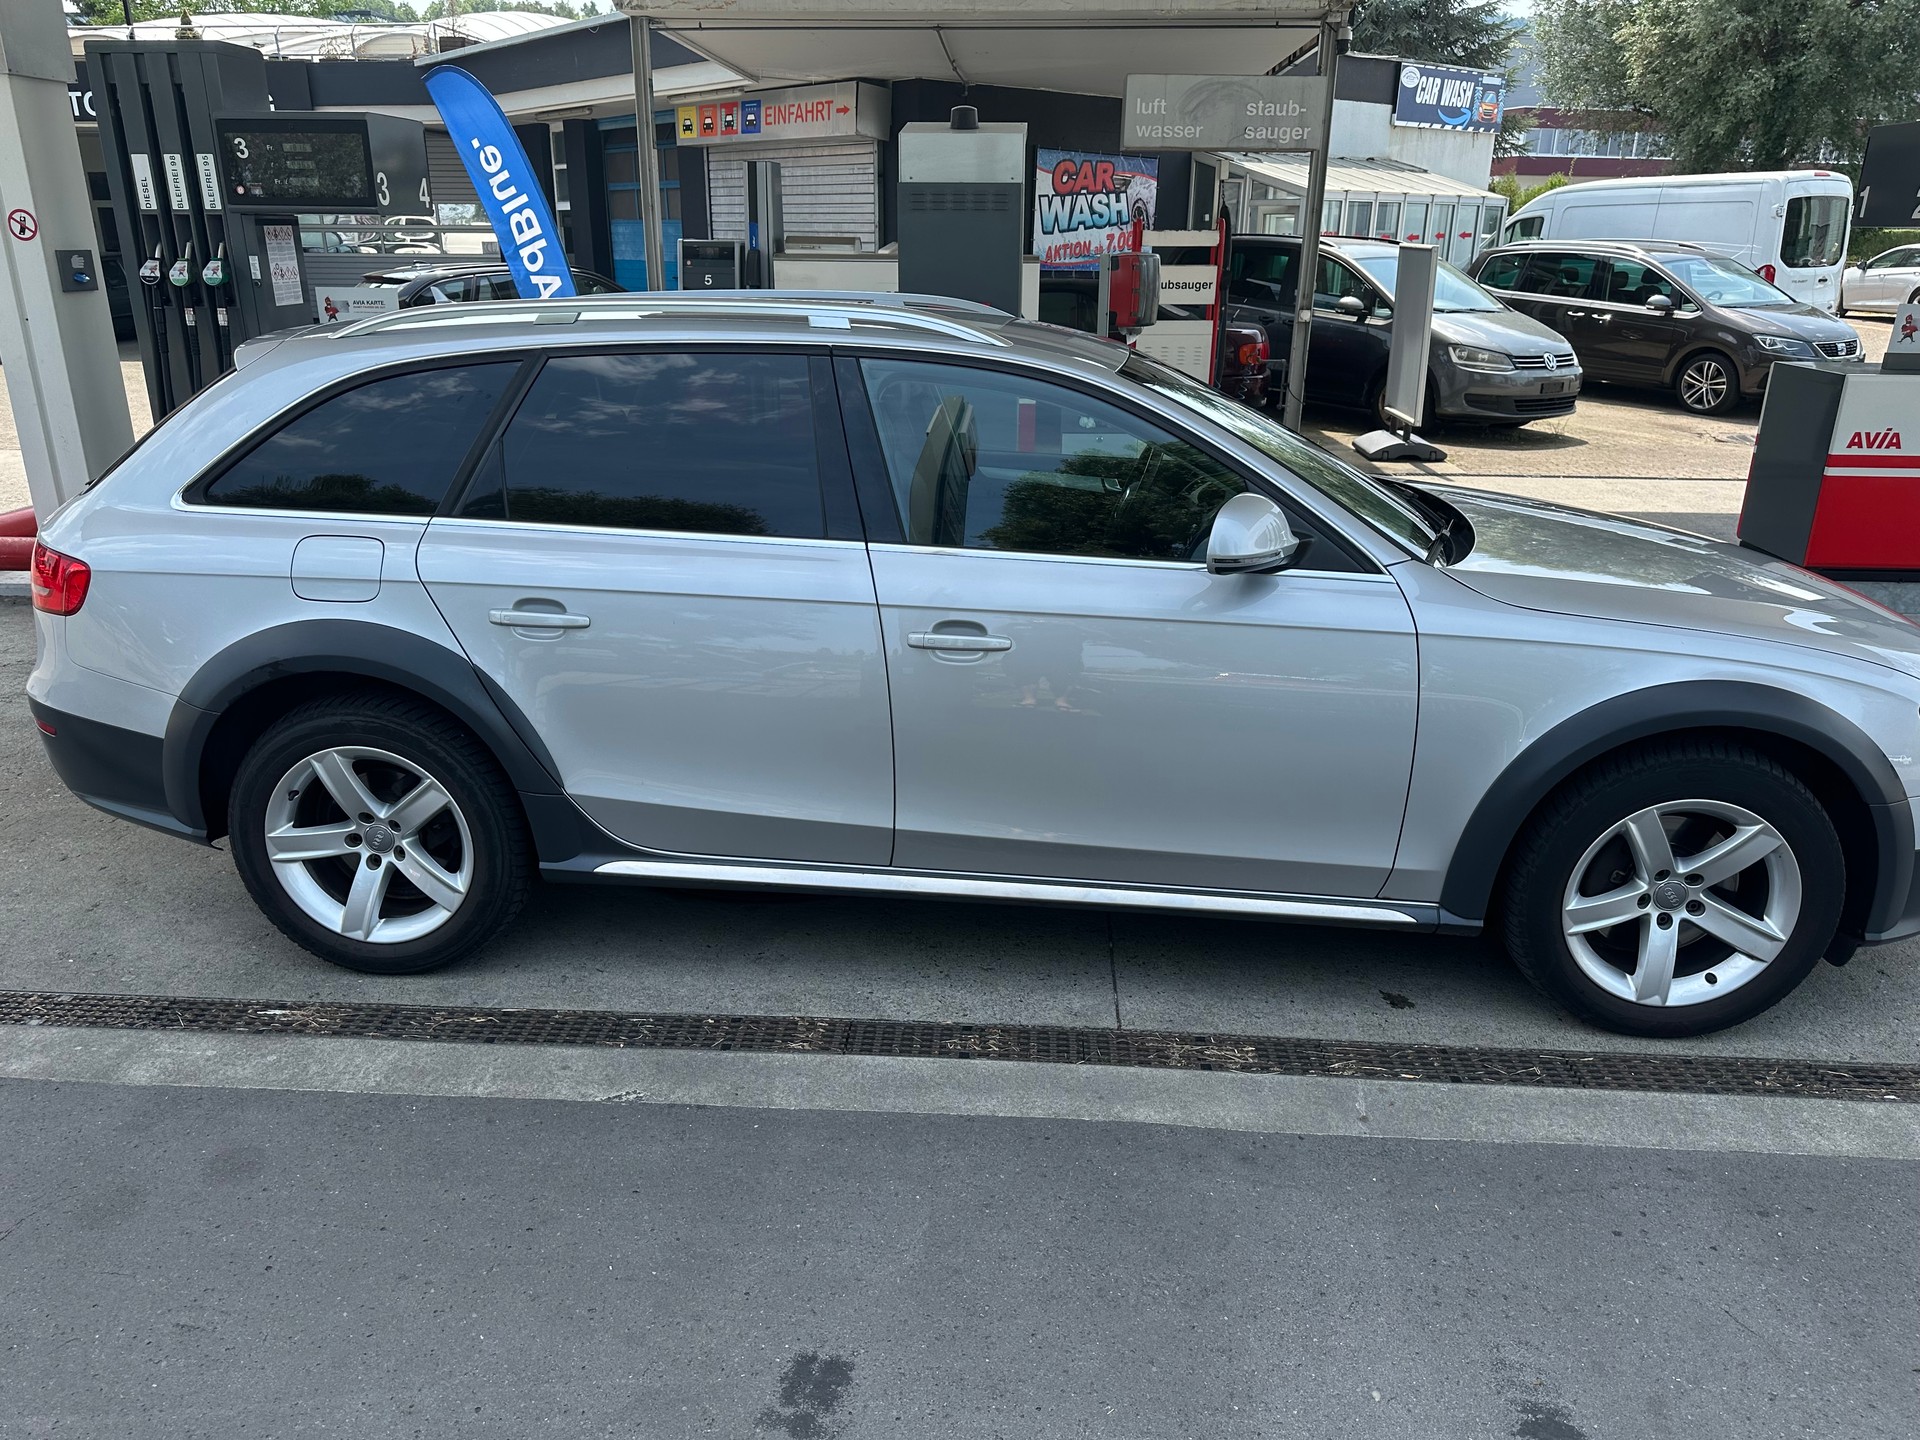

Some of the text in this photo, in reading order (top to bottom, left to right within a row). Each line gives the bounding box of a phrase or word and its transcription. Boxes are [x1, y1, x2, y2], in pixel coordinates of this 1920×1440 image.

[1136, 97, 1167, 115] luft
[1416, 76, 1442, 105] CAR
[1440, 78, 1475, 108] WASH
[764, 100, 834, 126] EINFAHRT
[1246, 99, 1307, 117] staub-
[1136, 124, 1204, 139] wasser
[1244, 126, 1311, 144] sauger
[233, 137, 250, 159] 3
[169, 155, 184, 209] BLEIFREI 98
[202, 155, 217, 209] BLEIFREI 95
[376, 171, 391, 206] 3
[1052, 158, 1116, 196] CAR
[140, 176, 152, 209] DIESEL
[418, 177, 430, 209] 4
[1859, 185, 1871, 218] 1
[1039, 191, 1131, 235] WASH
[1045, 240, 1092, 263] AKTION
[704, 274, 713, 286] 5
[1160, 280, 1213, 292] ubsauger
